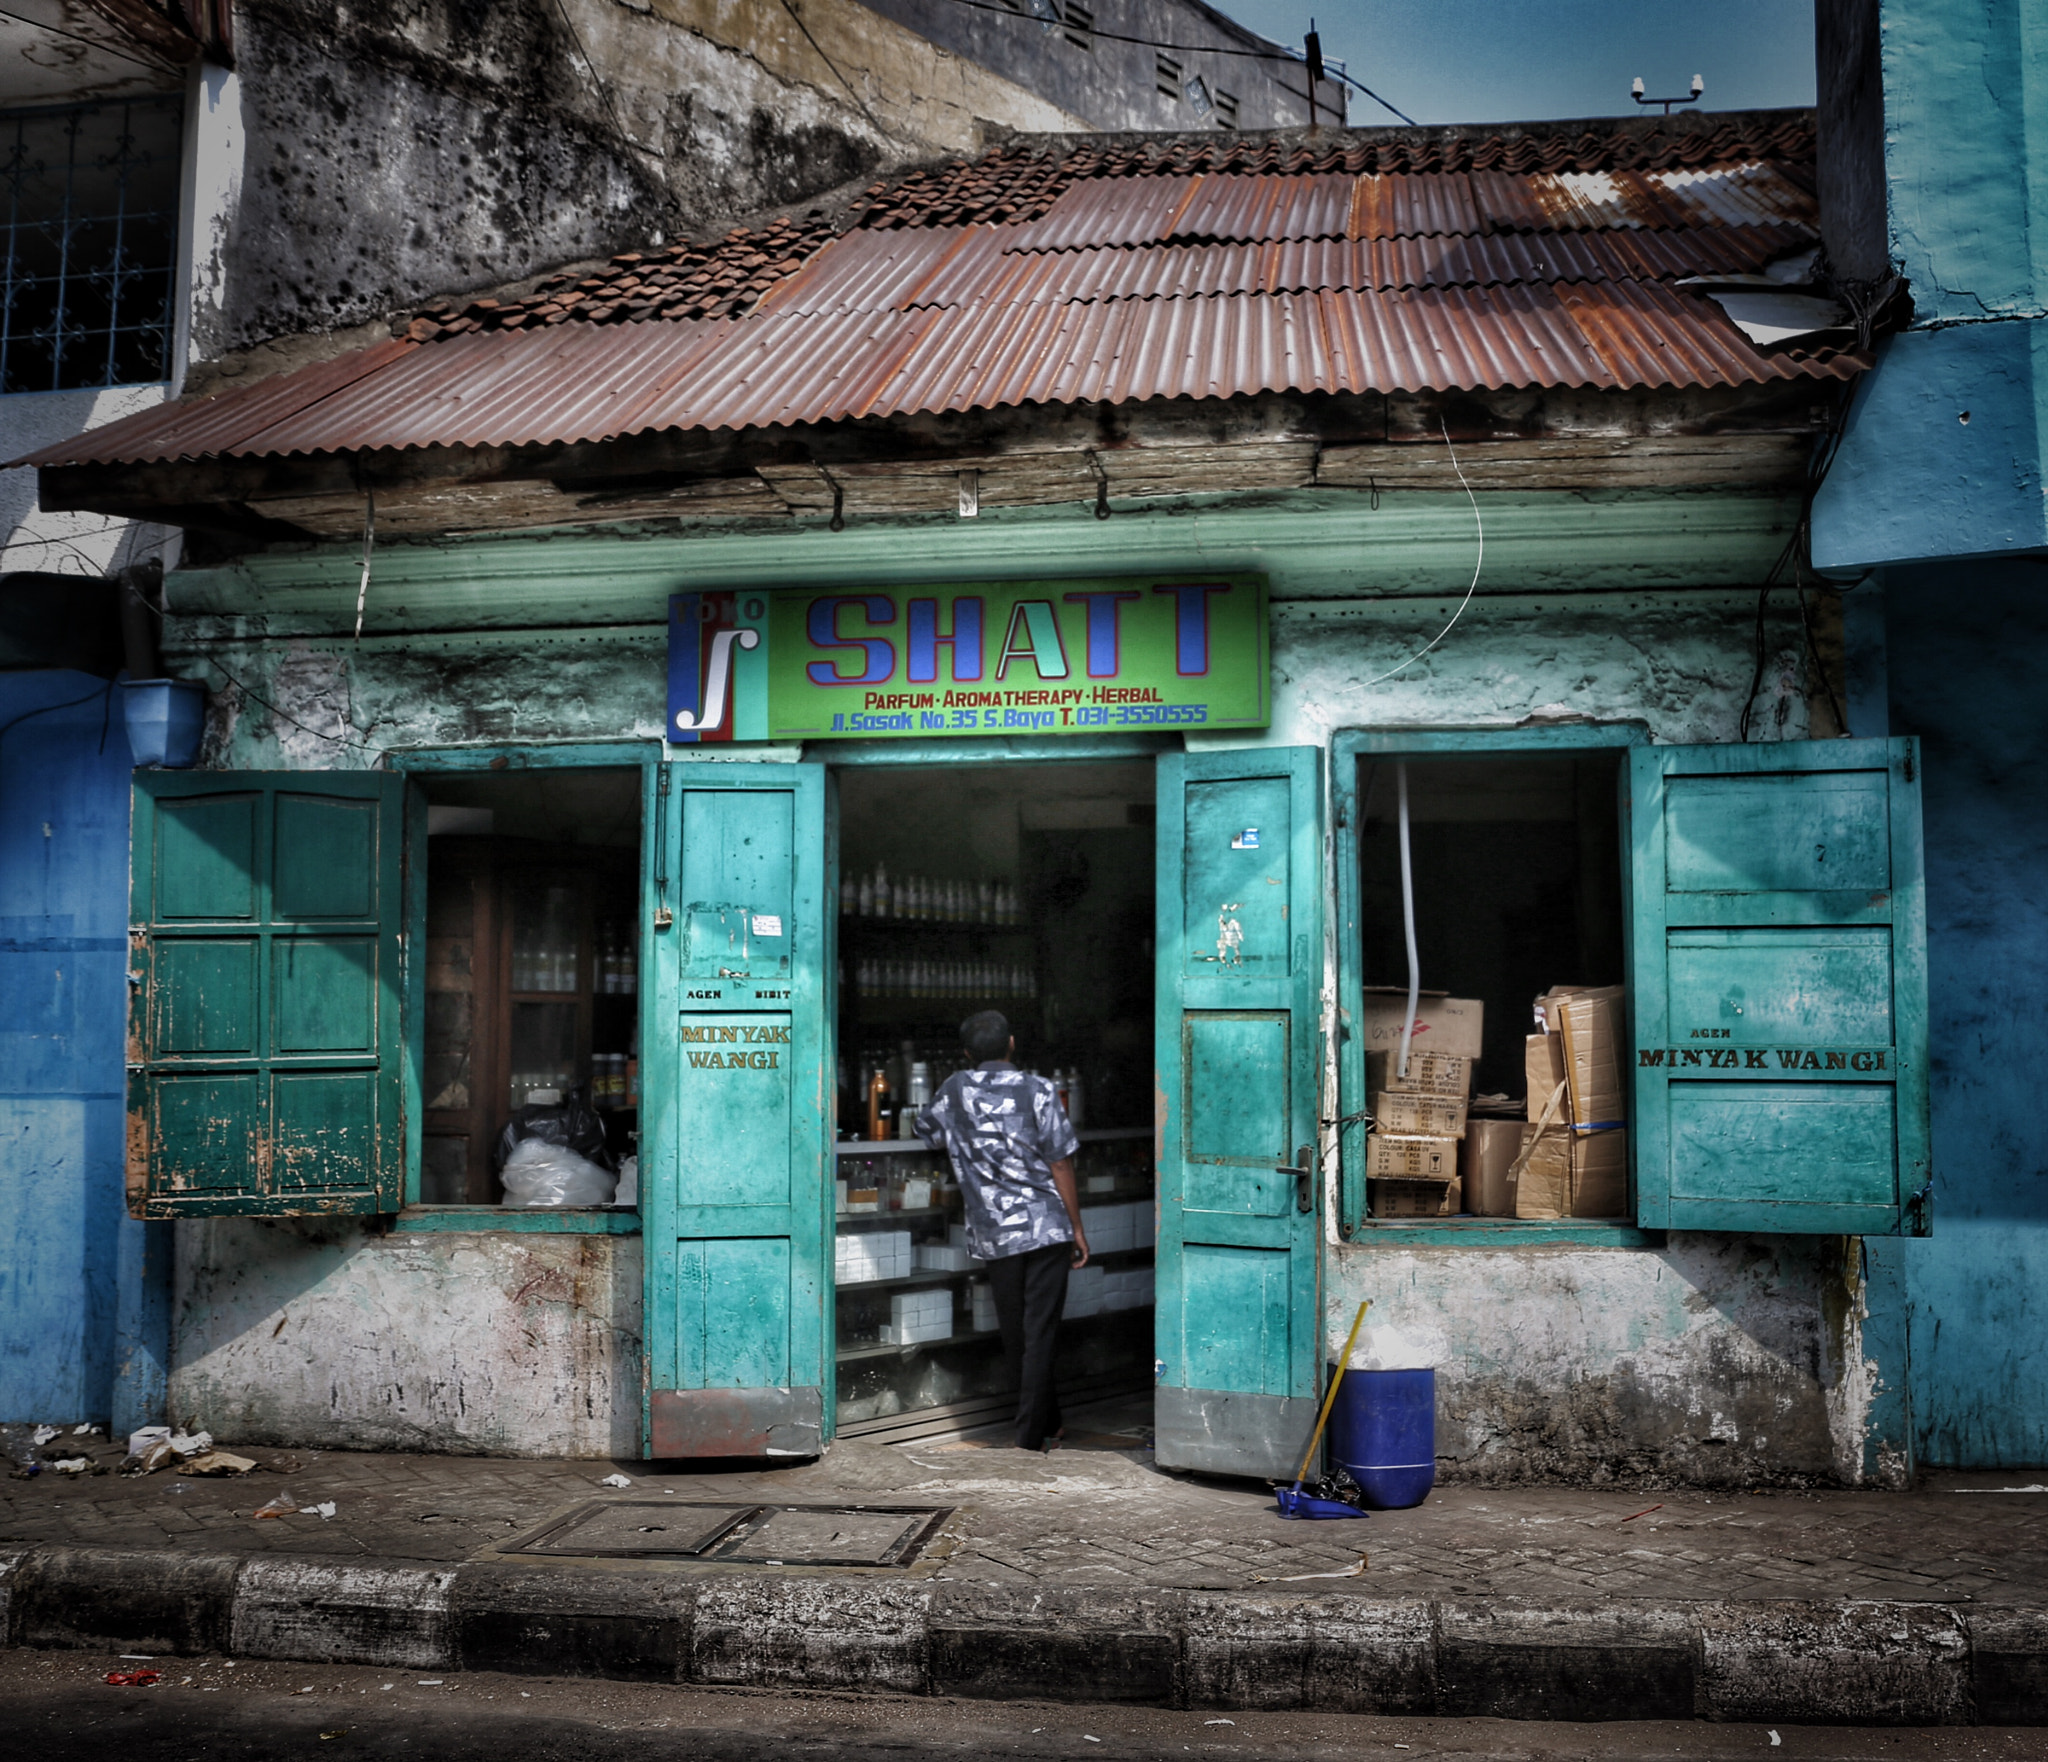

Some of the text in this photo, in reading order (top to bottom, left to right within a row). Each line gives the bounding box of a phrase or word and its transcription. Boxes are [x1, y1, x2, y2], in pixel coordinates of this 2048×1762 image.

[674, 598, 765, 623] TOKO
[805, 583, 1232, 686] SHATT
[1093, 686, 1163, 704] HERBAL
[920, 710, 977, 729] No.35
[686, 990, 721, 999] AGEN
[681, 1026, 792, 1043] MINYAK
[1690, 1028, 1731, 1038] AGEN
[687, 1051, 779, 1069] WANGI
[1638, 1049, 1888, 1071] MINYAK WANGI
